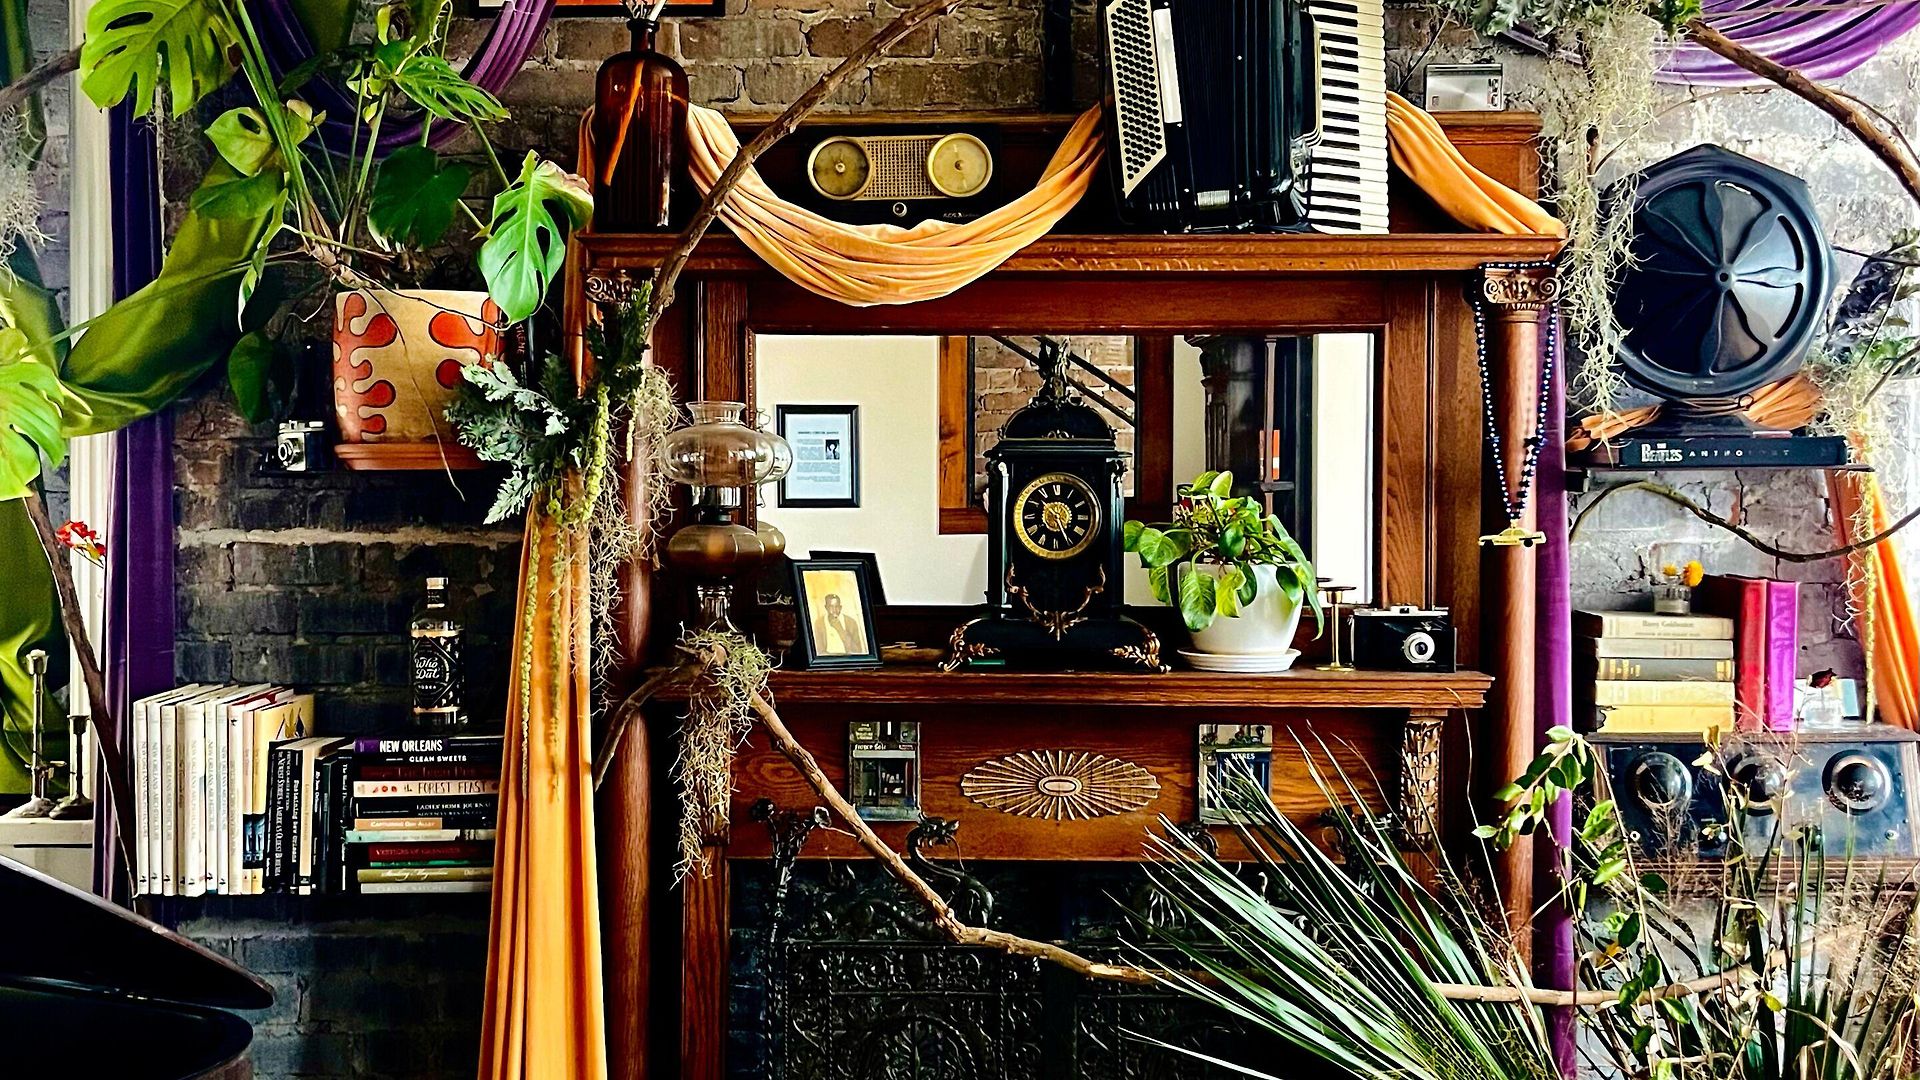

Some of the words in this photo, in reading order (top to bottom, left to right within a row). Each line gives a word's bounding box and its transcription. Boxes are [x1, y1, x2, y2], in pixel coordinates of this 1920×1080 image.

[1641, 443, 1683, 463] BEATLES
[414, 657, 438, 669] Who
[415, 668, 440, 680] Dat
[379, 740, 400, 753] NEW
[402, 739, 443, 752] ORLEANS
[418, 782, 450, 794] FOREST
[458, 781, 487, 793] FEAST
